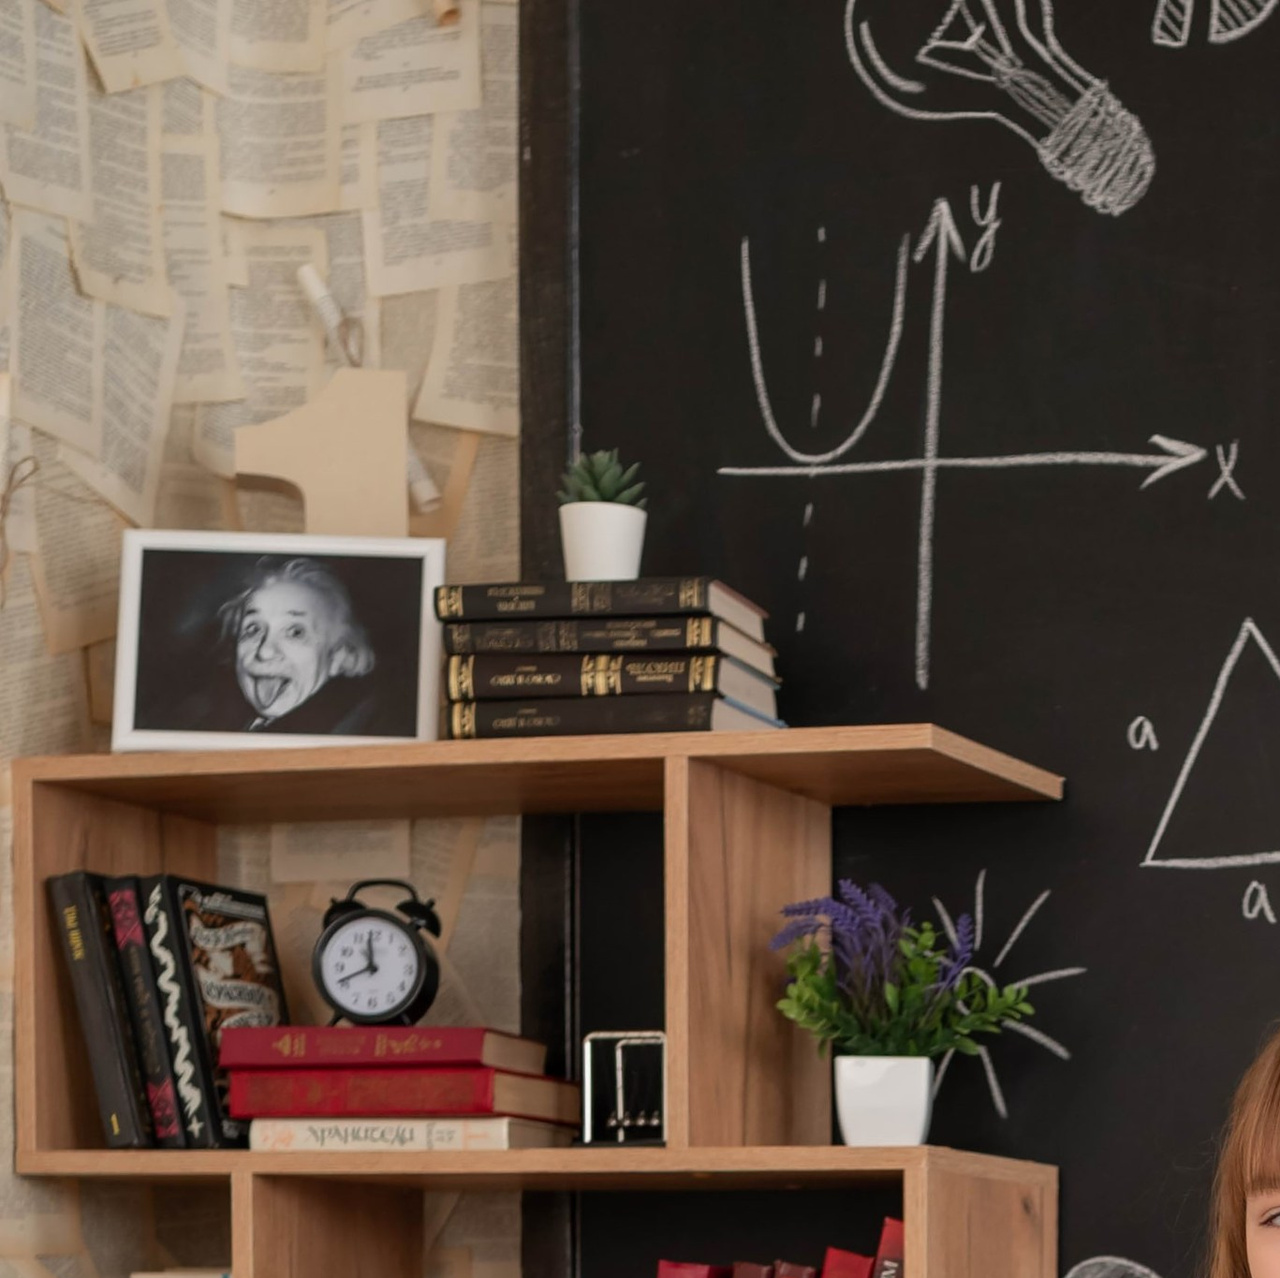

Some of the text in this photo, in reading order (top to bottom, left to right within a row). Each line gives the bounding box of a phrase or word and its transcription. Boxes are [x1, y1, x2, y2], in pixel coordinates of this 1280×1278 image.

[970, 182, 1001, 272] y
[1127, 716, 1159, 751] a
[1242, 881, 1277, 924] a
